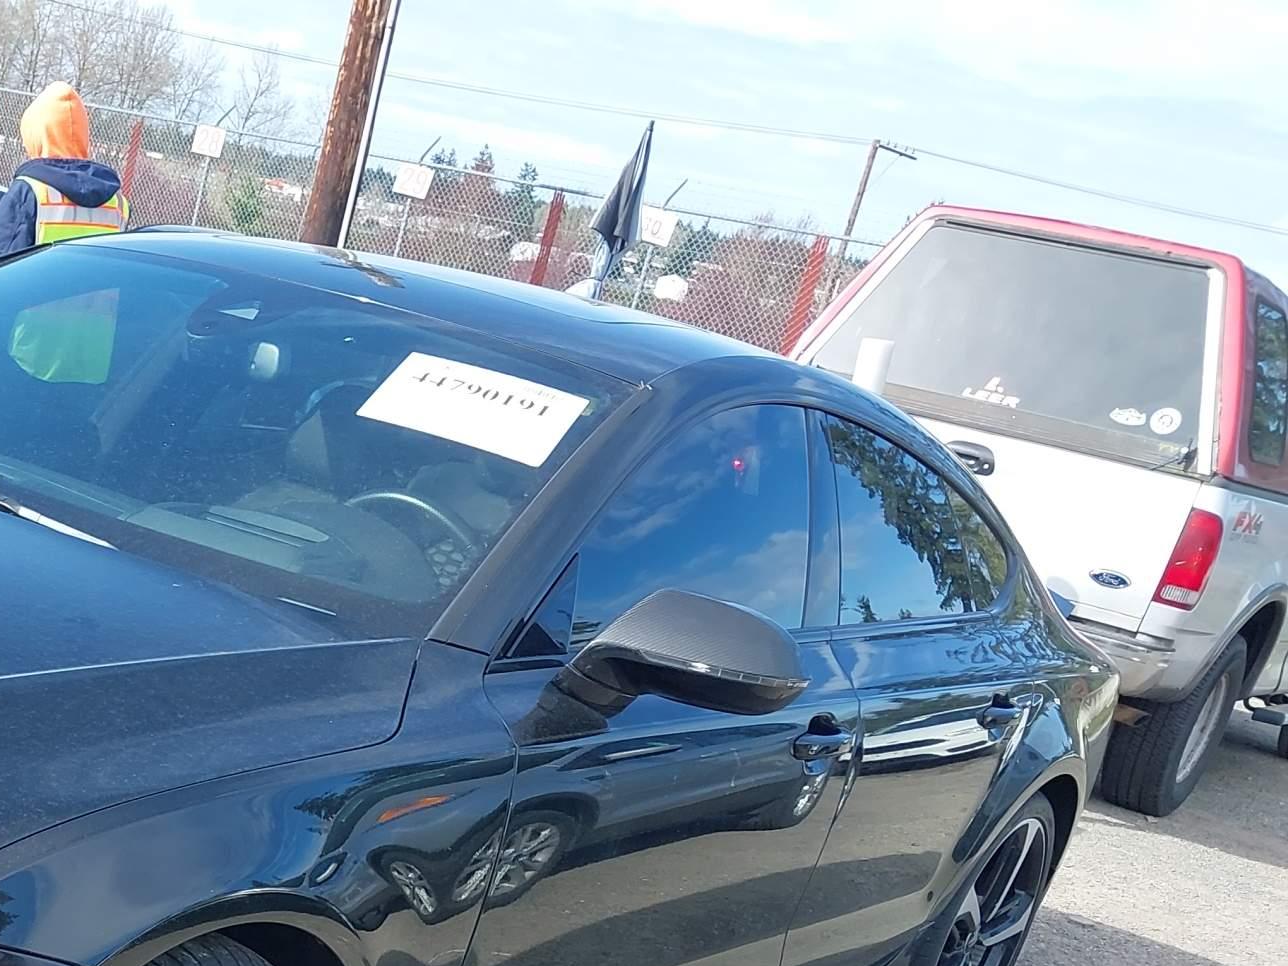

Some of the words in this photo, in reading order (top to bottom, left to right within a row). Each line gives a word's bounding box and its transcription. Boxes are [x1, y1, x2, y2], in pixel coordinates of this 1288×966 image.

[398, 167, 429, 195] 29
[411, 371, 550, 417] 44790191
[1233, 511, 1263, 535] FX4
